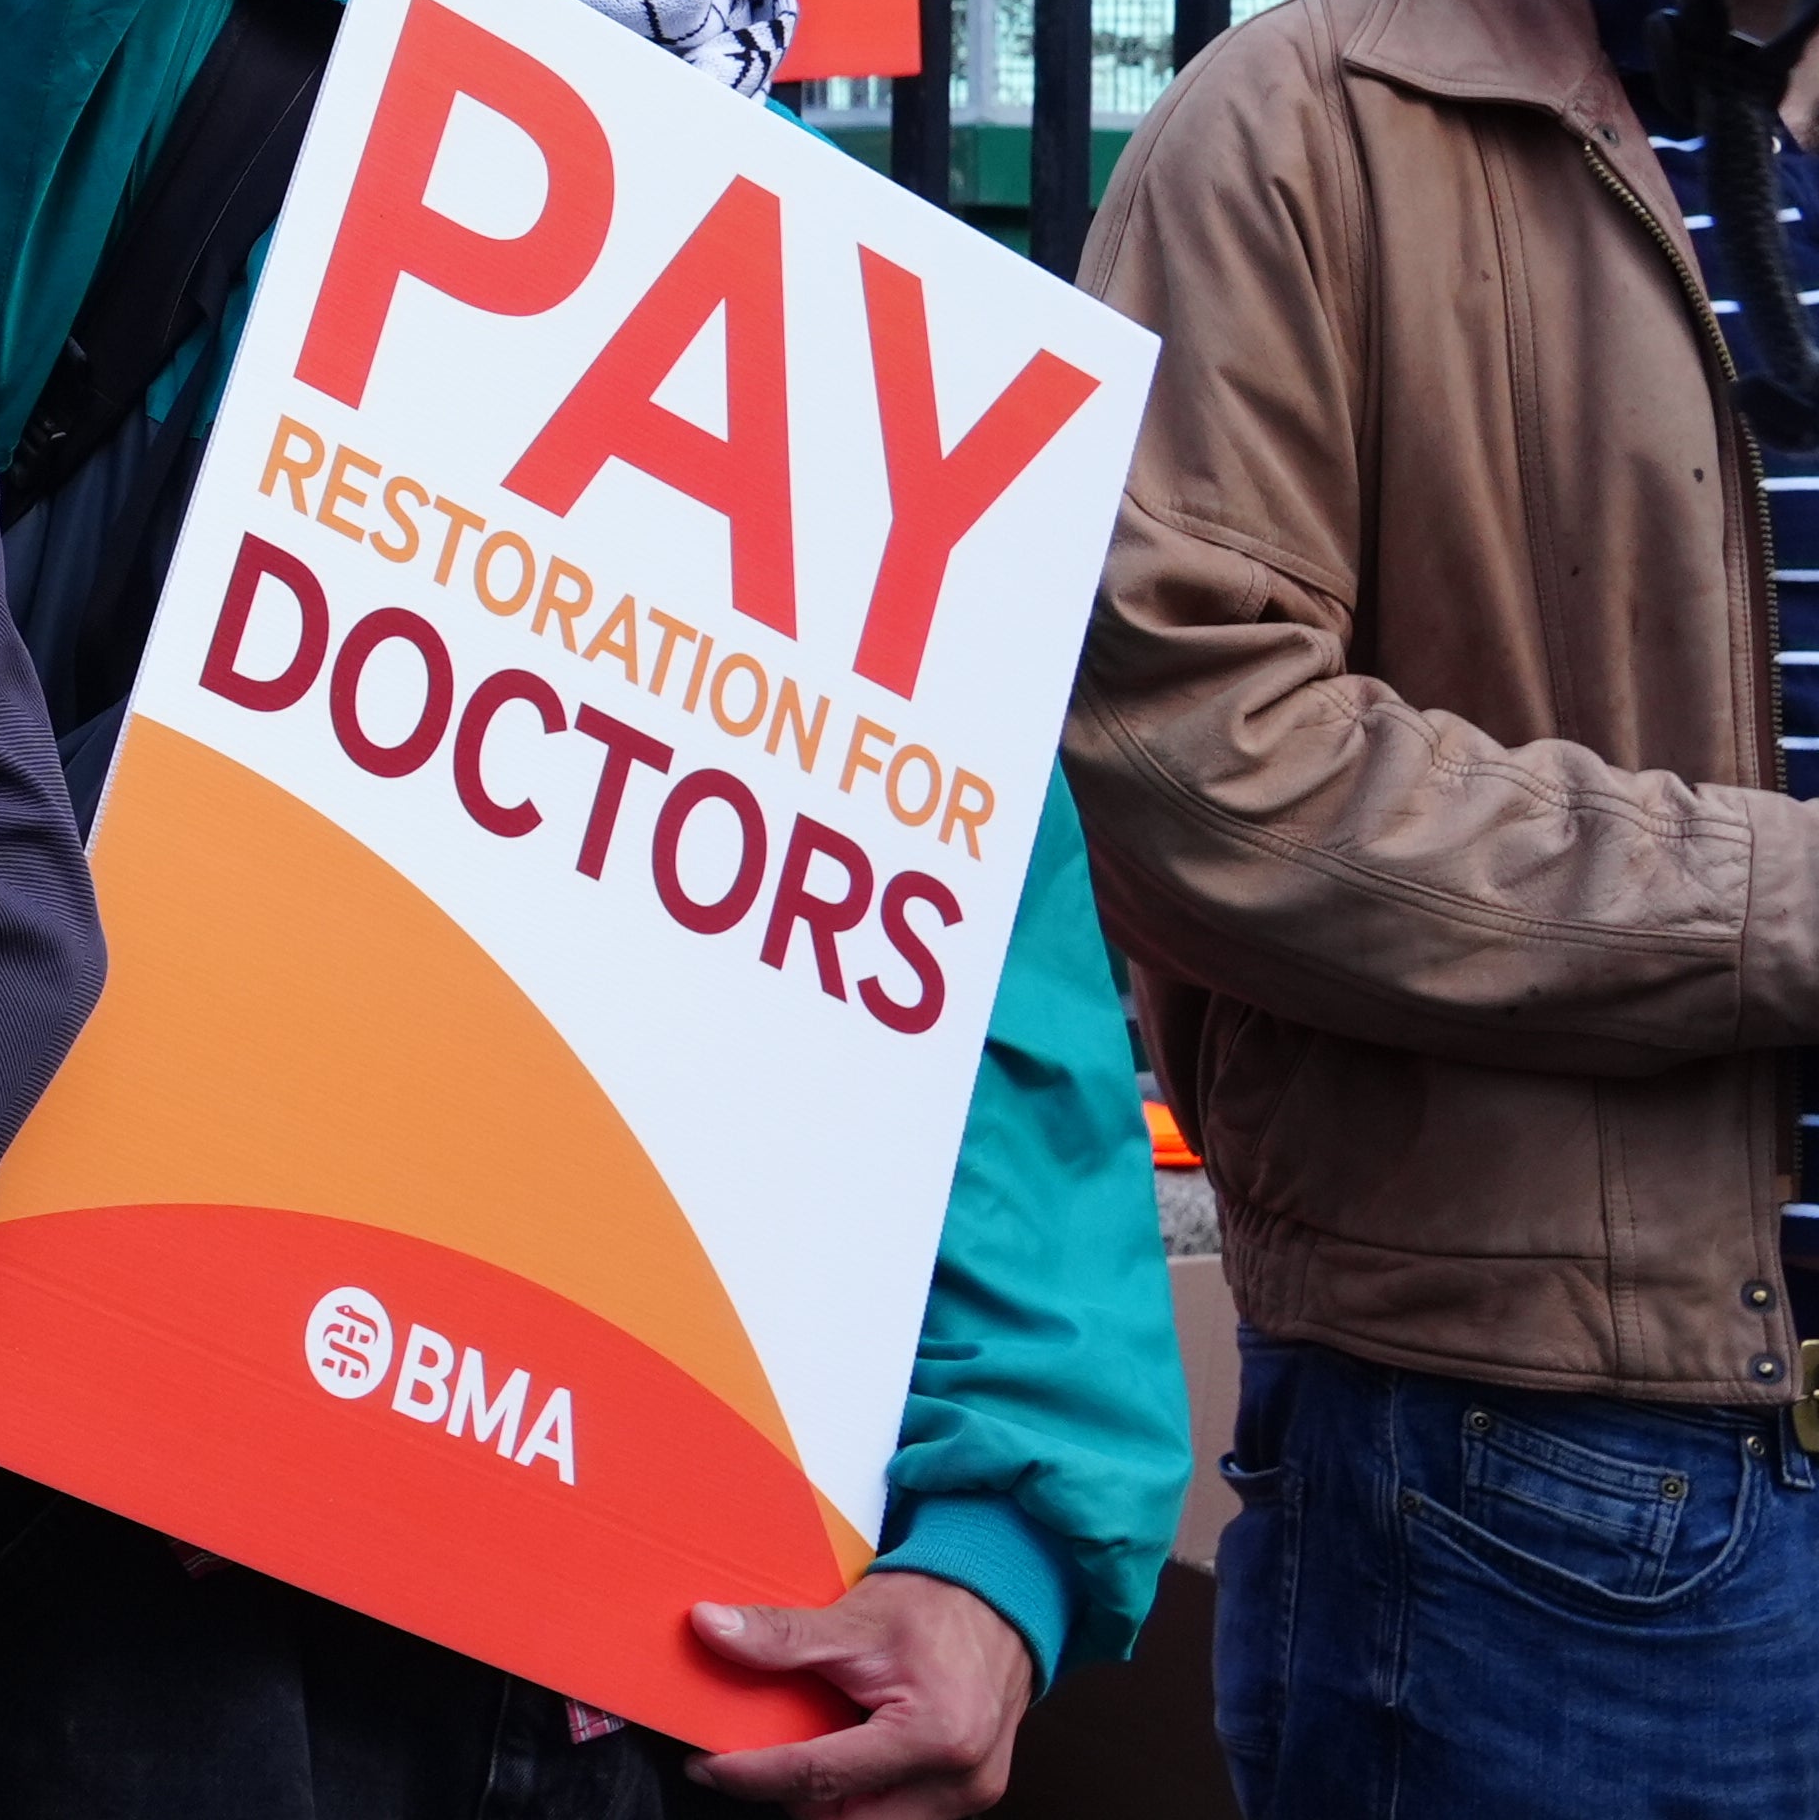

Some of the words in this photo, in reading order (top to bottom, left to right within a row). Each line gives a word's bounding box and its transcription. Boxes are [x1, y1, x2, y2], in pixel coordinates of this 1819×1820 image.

[198, 532, 965, 1037] DOCTORS
[258, 413, 830, 775] RESTORATION
[842, 709, 998, 860] FOR
[391, 1319, 576, 1486] BMA
